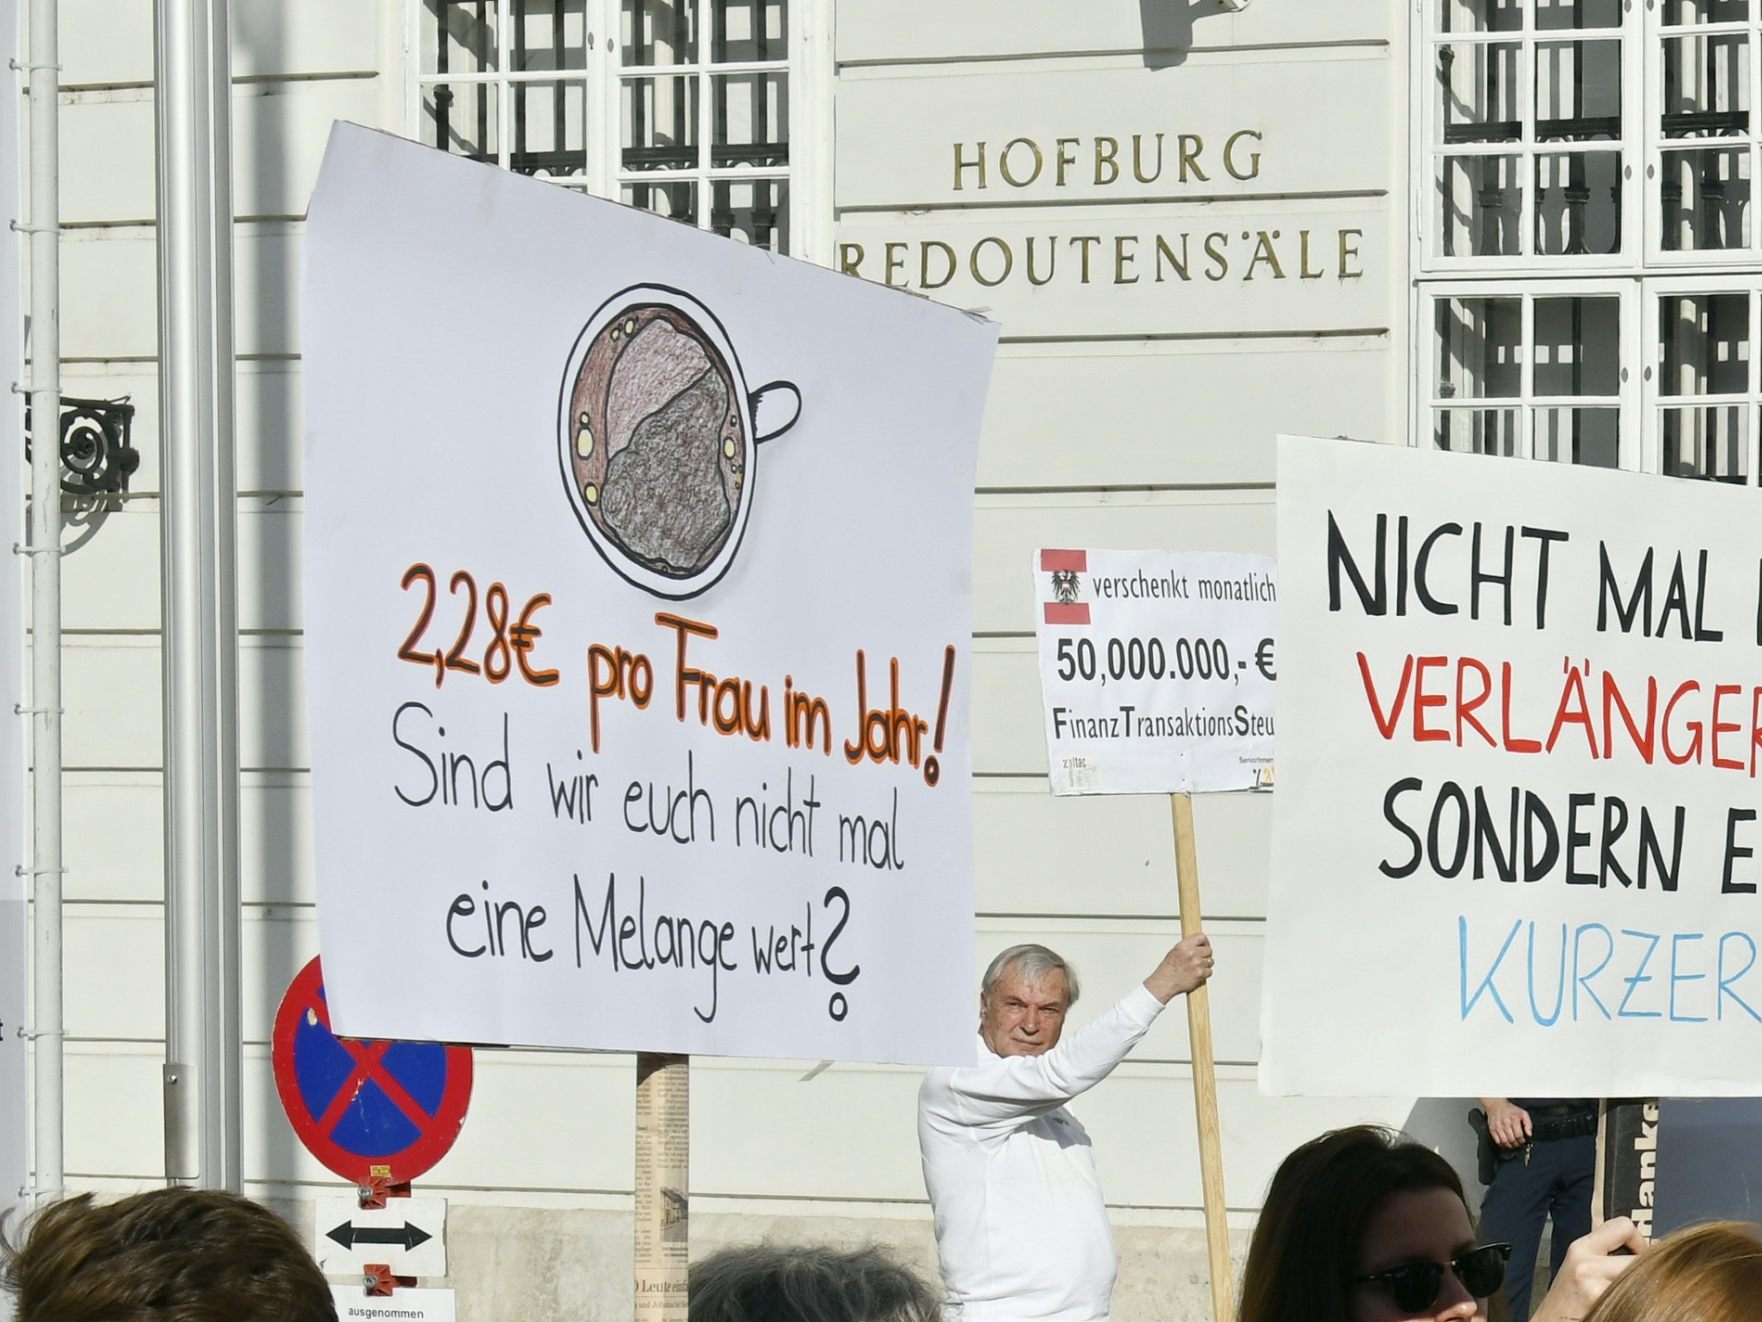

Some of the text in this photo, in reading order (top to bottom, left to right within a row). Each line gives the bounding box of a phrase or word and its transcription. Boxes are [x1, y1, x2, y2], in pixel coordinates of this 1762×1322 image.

[952, 129, 1264, 191] HOFBURG
[840, 229, 1364, 289] REDOUTENSÄLE
[1092, 569, 1277, 602] verschenkt monatlich
[1327, 509, 1569, 630] NICHT
[1597, 540, 1723, 642] MAL
[397, 562, 956, 787] 2,28€ pro Frau im Jahr!
[1052, 704, 1275, 740] FinanzTransaktionsSteu
[392, 701, 905, 871] Sind wir euch nicht mal
[1378, 777, 1686, 892] SONDERN
[446, 872, 861, 1022] eine Melange wert?
[1458, 915, 1762, 1027] KURZER
[348, 1307, 425, 1320] ausgenommen
